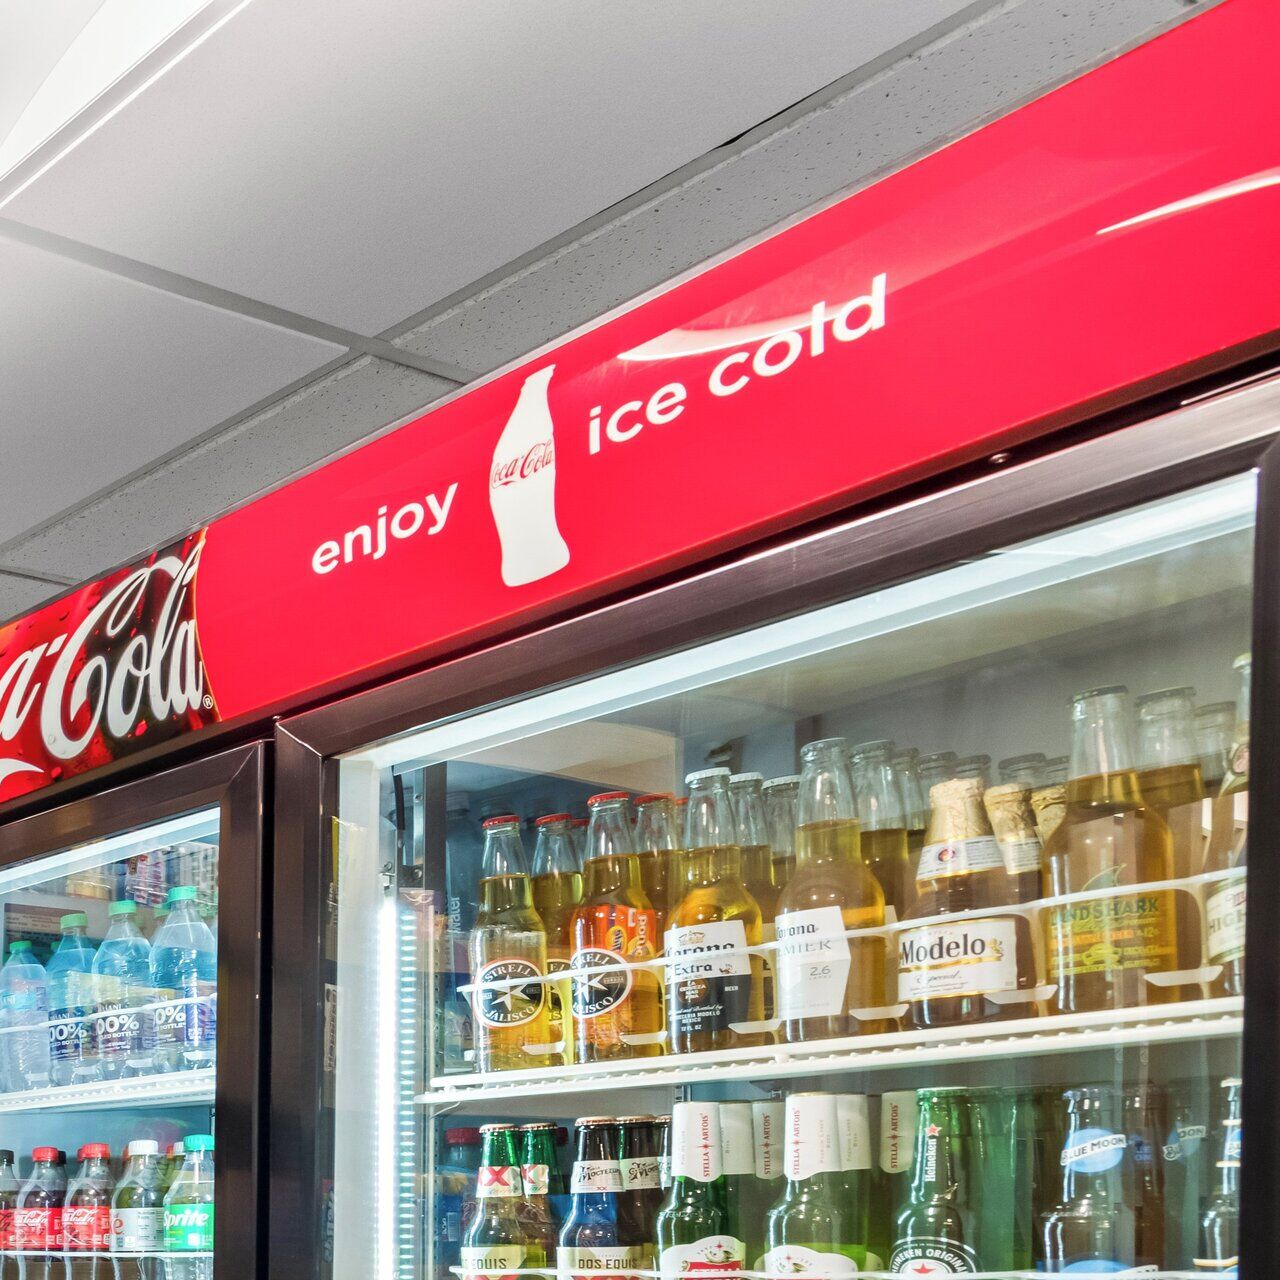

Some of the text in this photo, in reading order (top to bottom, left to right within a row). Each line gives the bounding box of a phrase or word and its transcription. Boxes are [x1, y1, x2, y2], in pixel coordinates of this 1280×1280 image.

[587, 273, 888, 455] ice cold
[491, 439, 553, 489] Coca-Cola
[311, 482, 458, 575] enjoy
[900, 934, 986, 966] Modelo
[674, 964, 713, 975] Extra
[810, 965, 831, 976] 2.6
[487, 1004, 537, 1023] JALISCO
[701, 1114, 711, 1177] STELLA ARTOIS
[793, 1109, 801, 1177] STELLA ARTOIS
[890, 1104, 899, 1169] STELLA ARTOIS
[1060, 1134, 1126, 1165] BLUE MOON
[925, 1138, 937, 1182] Heineken
[164, 1209, 209, 1227] Sprite
[472, 1258, 507, 1270] EQUIS
[578, 1258, 638, 1270] DOS EQUIS
